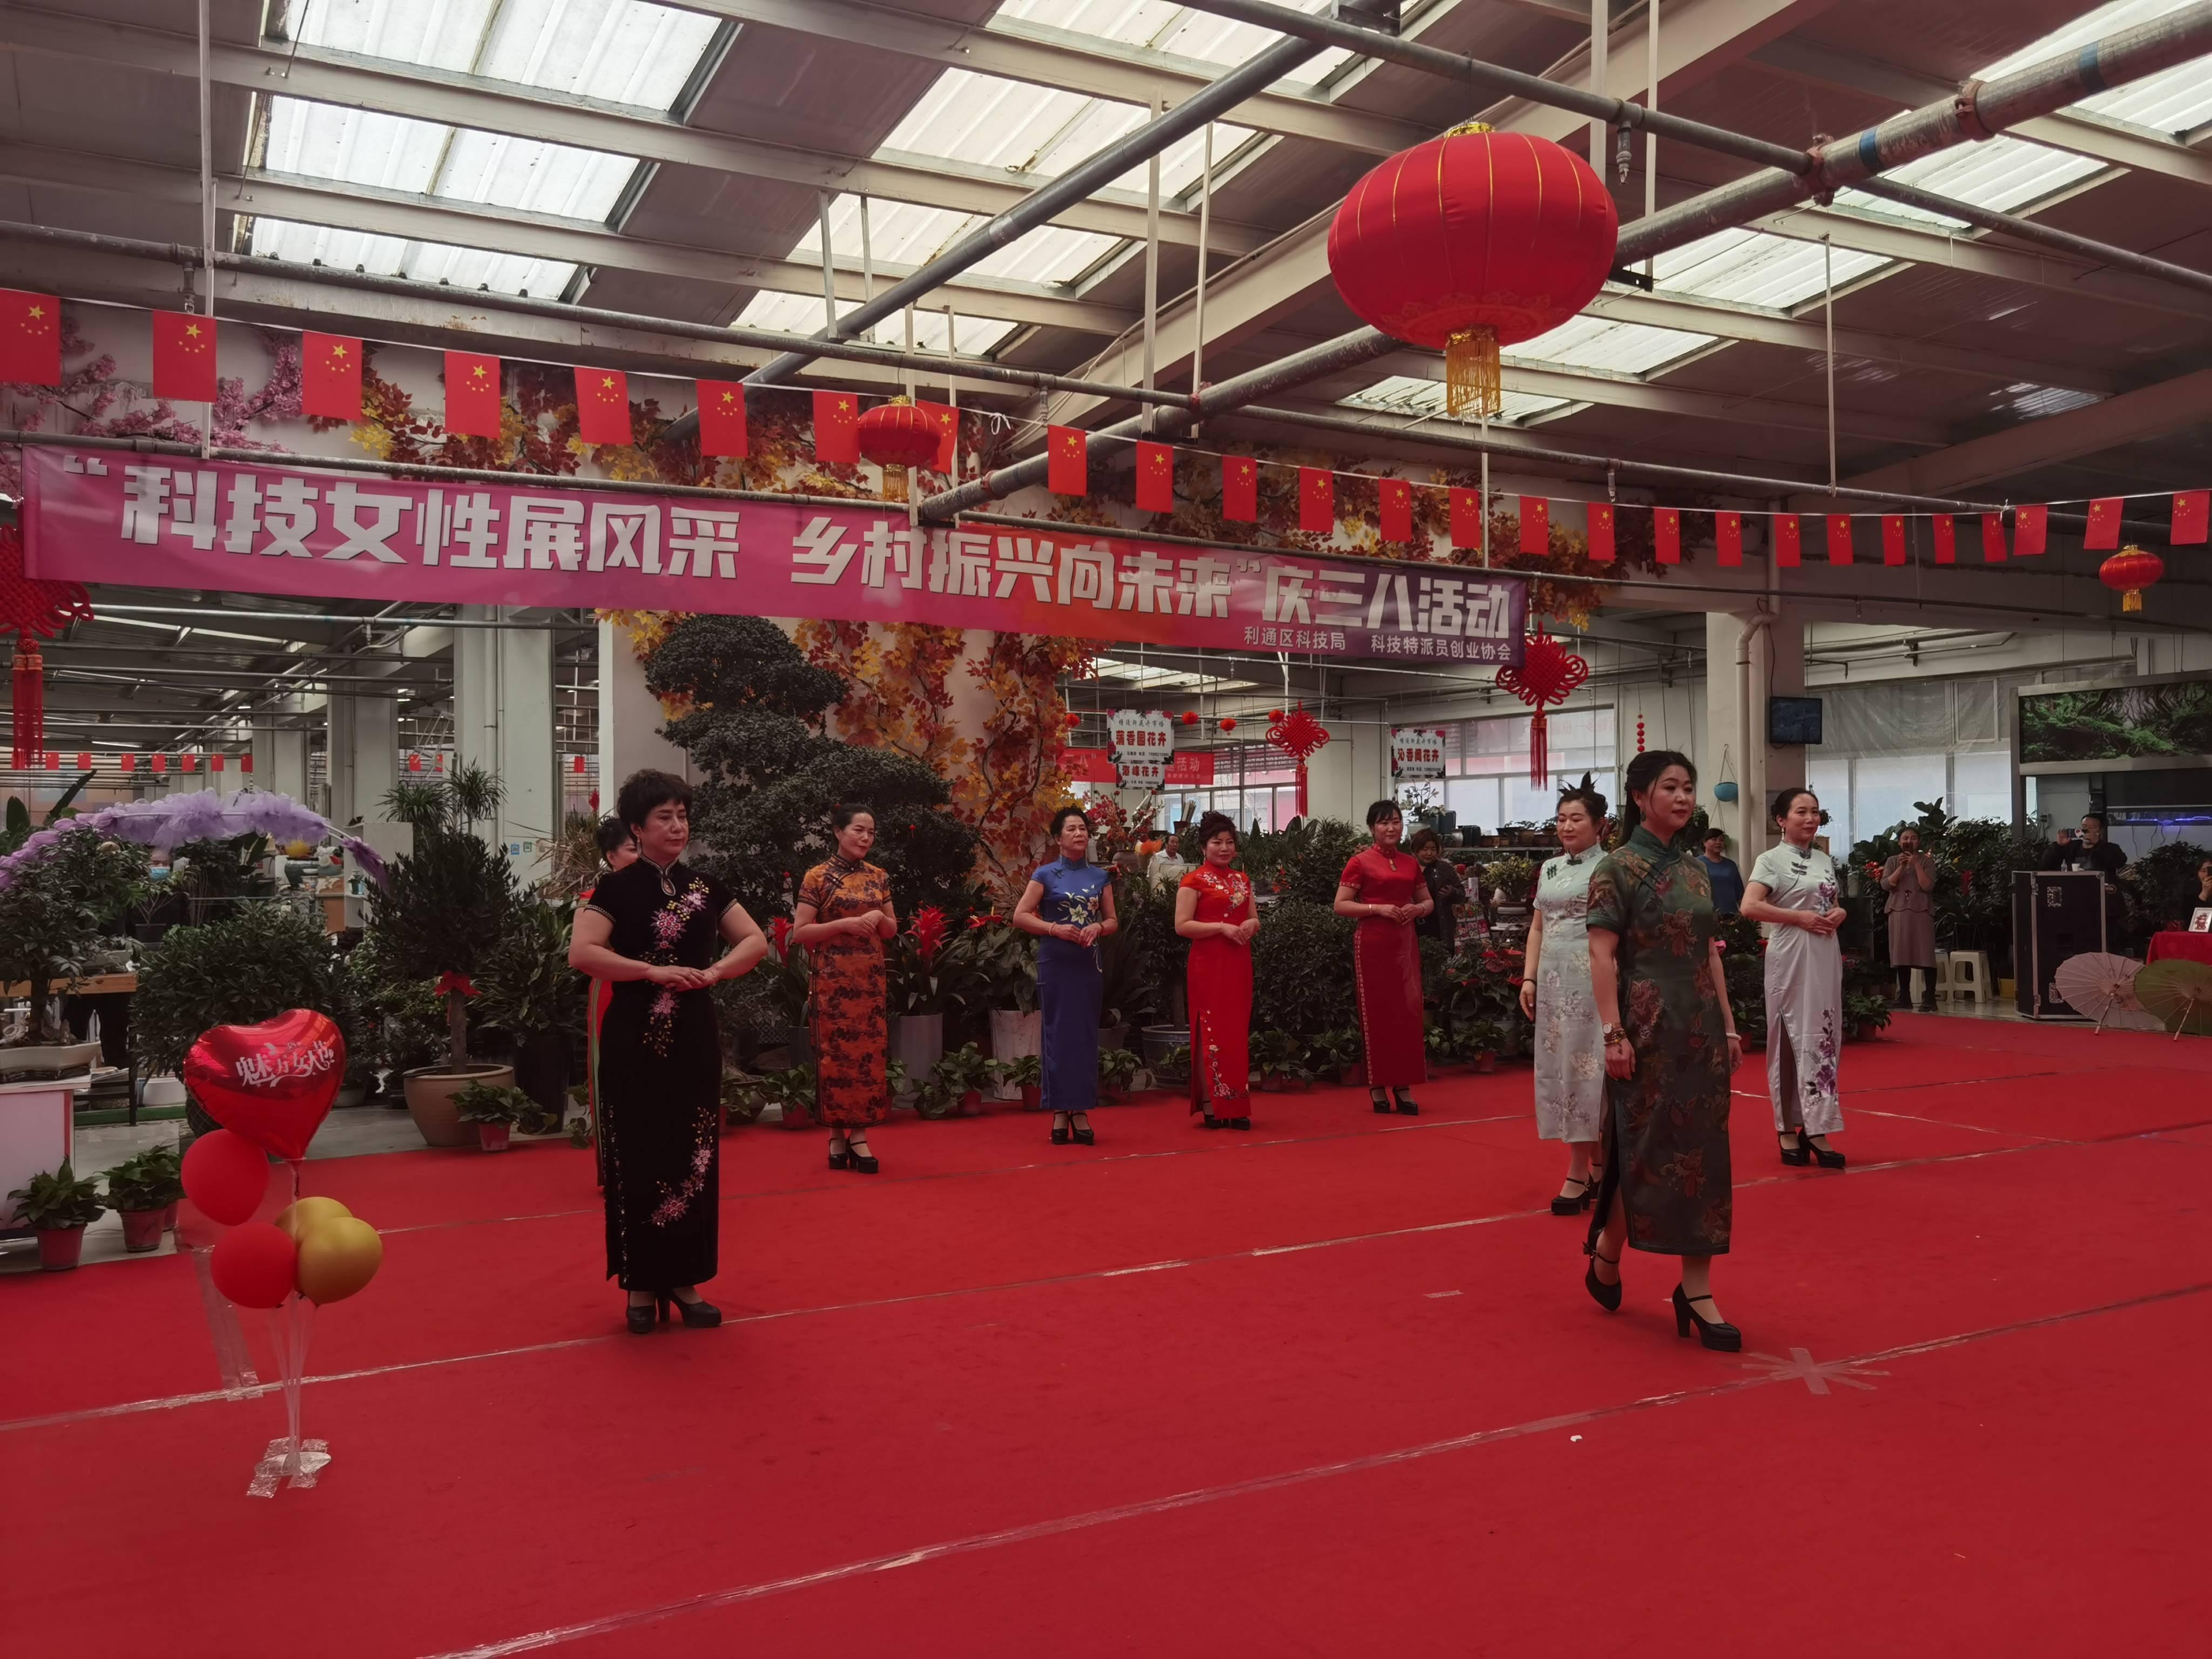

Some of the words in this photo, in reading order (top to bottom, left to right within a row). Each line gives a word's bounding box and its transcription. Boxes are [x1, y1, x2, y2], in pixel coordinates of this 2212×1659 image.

[1244, 625, 1346, 651] 利通区科技局
[1371, 634, 1512, 661] 科技特派员创业协会
[1116, 730, 1166, 747] 蒲香园花卉
